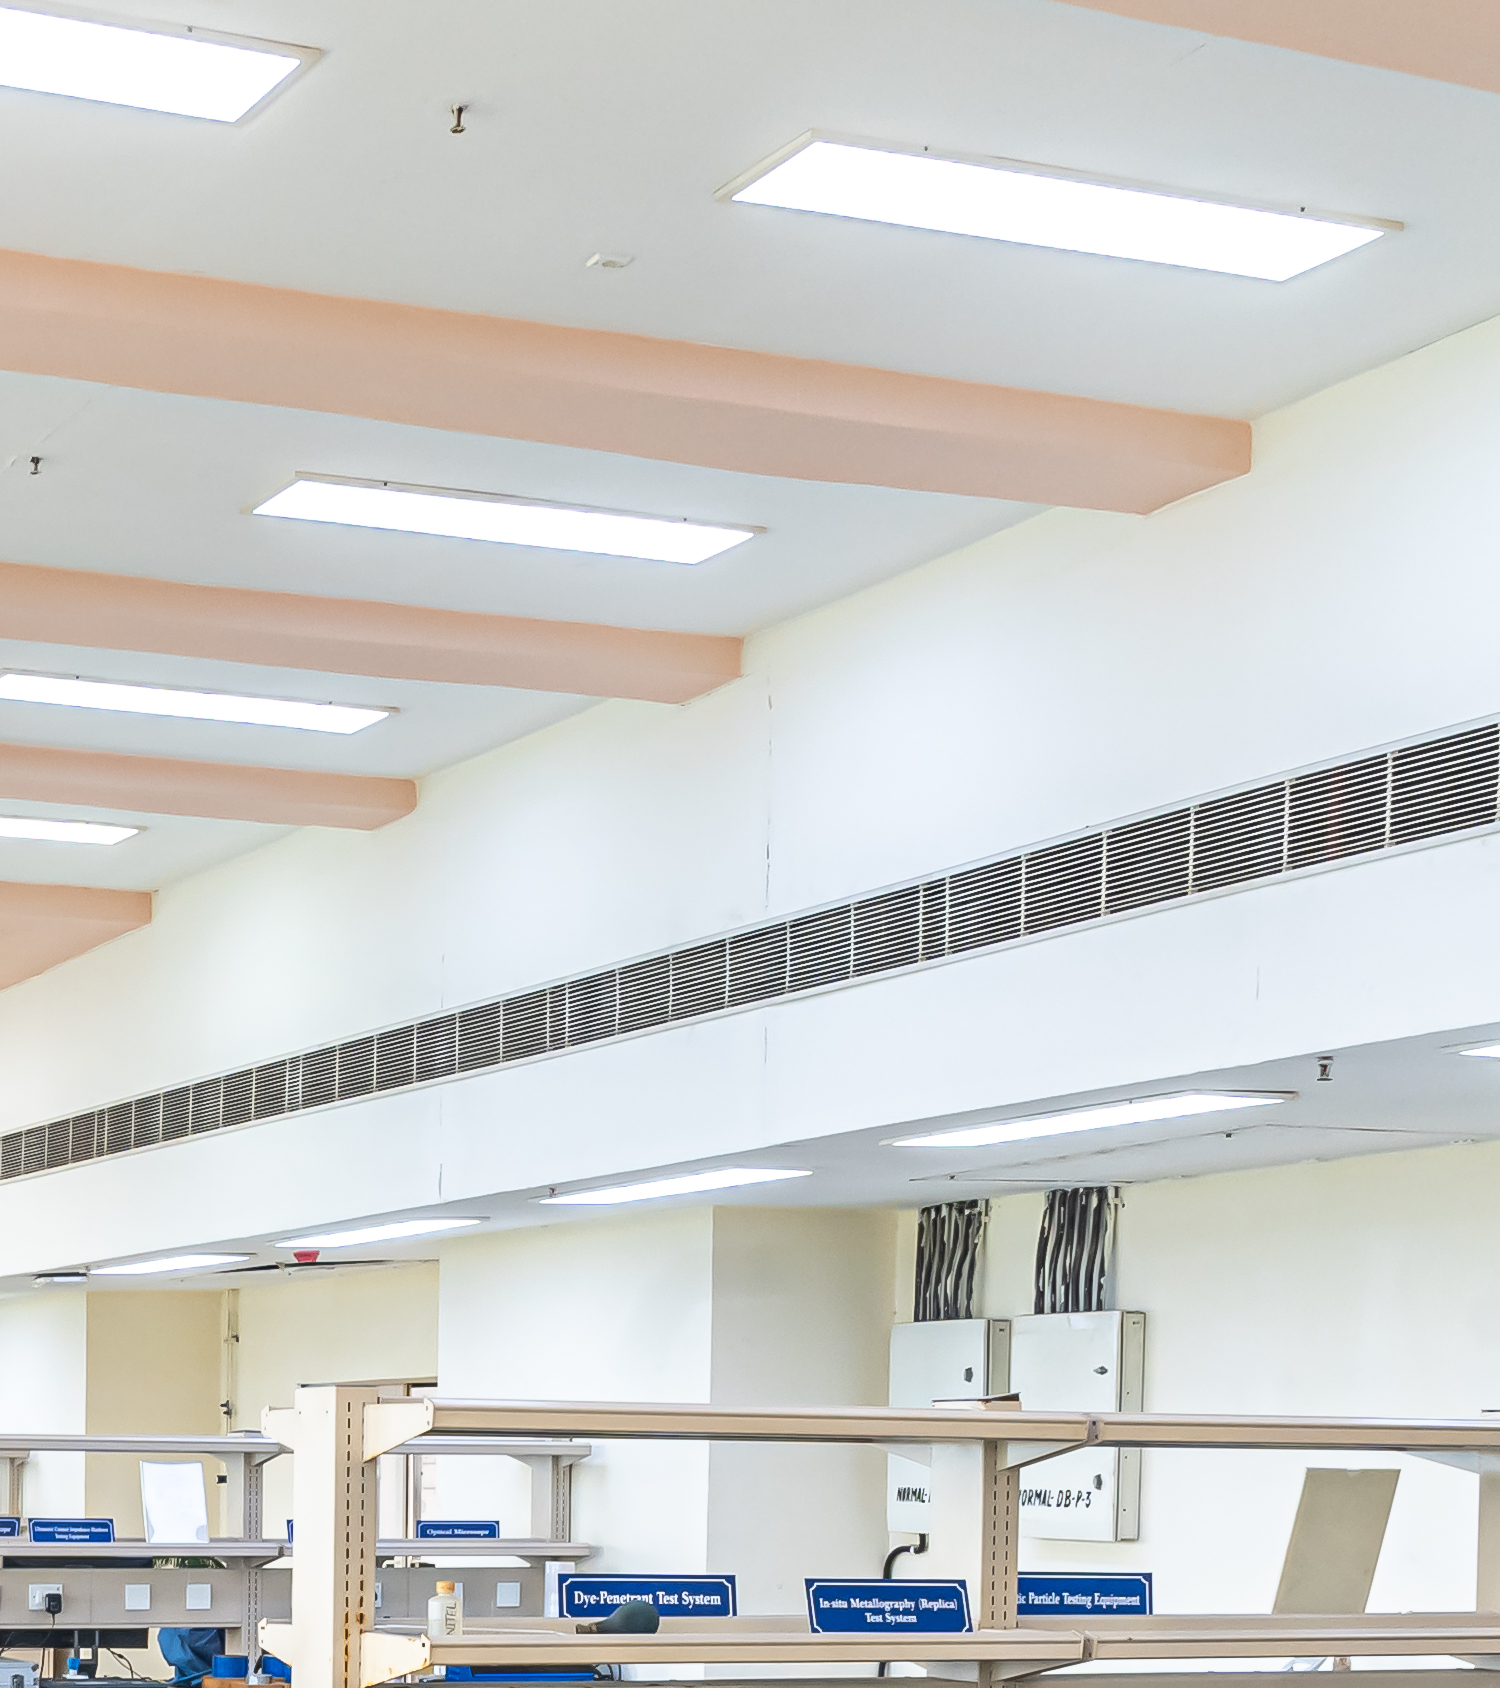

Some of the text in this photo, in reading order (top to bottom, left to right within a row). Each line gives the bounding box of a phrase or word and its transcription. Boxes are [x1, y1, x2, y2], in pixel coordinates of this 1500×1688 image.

[573, 1590, 722, 1609] Dye-Penetrant Test System
[850, 1598, 916, 1612] Metallography
[918, 1598, 958, 1612] (Replica)
[1028, 1592, 1061, 1605] Particle
[1062, 1592, 1093, 1609] Testing
[1094, 1593, 1141, 1609] Equipment
[865, 1612, 918, 1626] Test System
